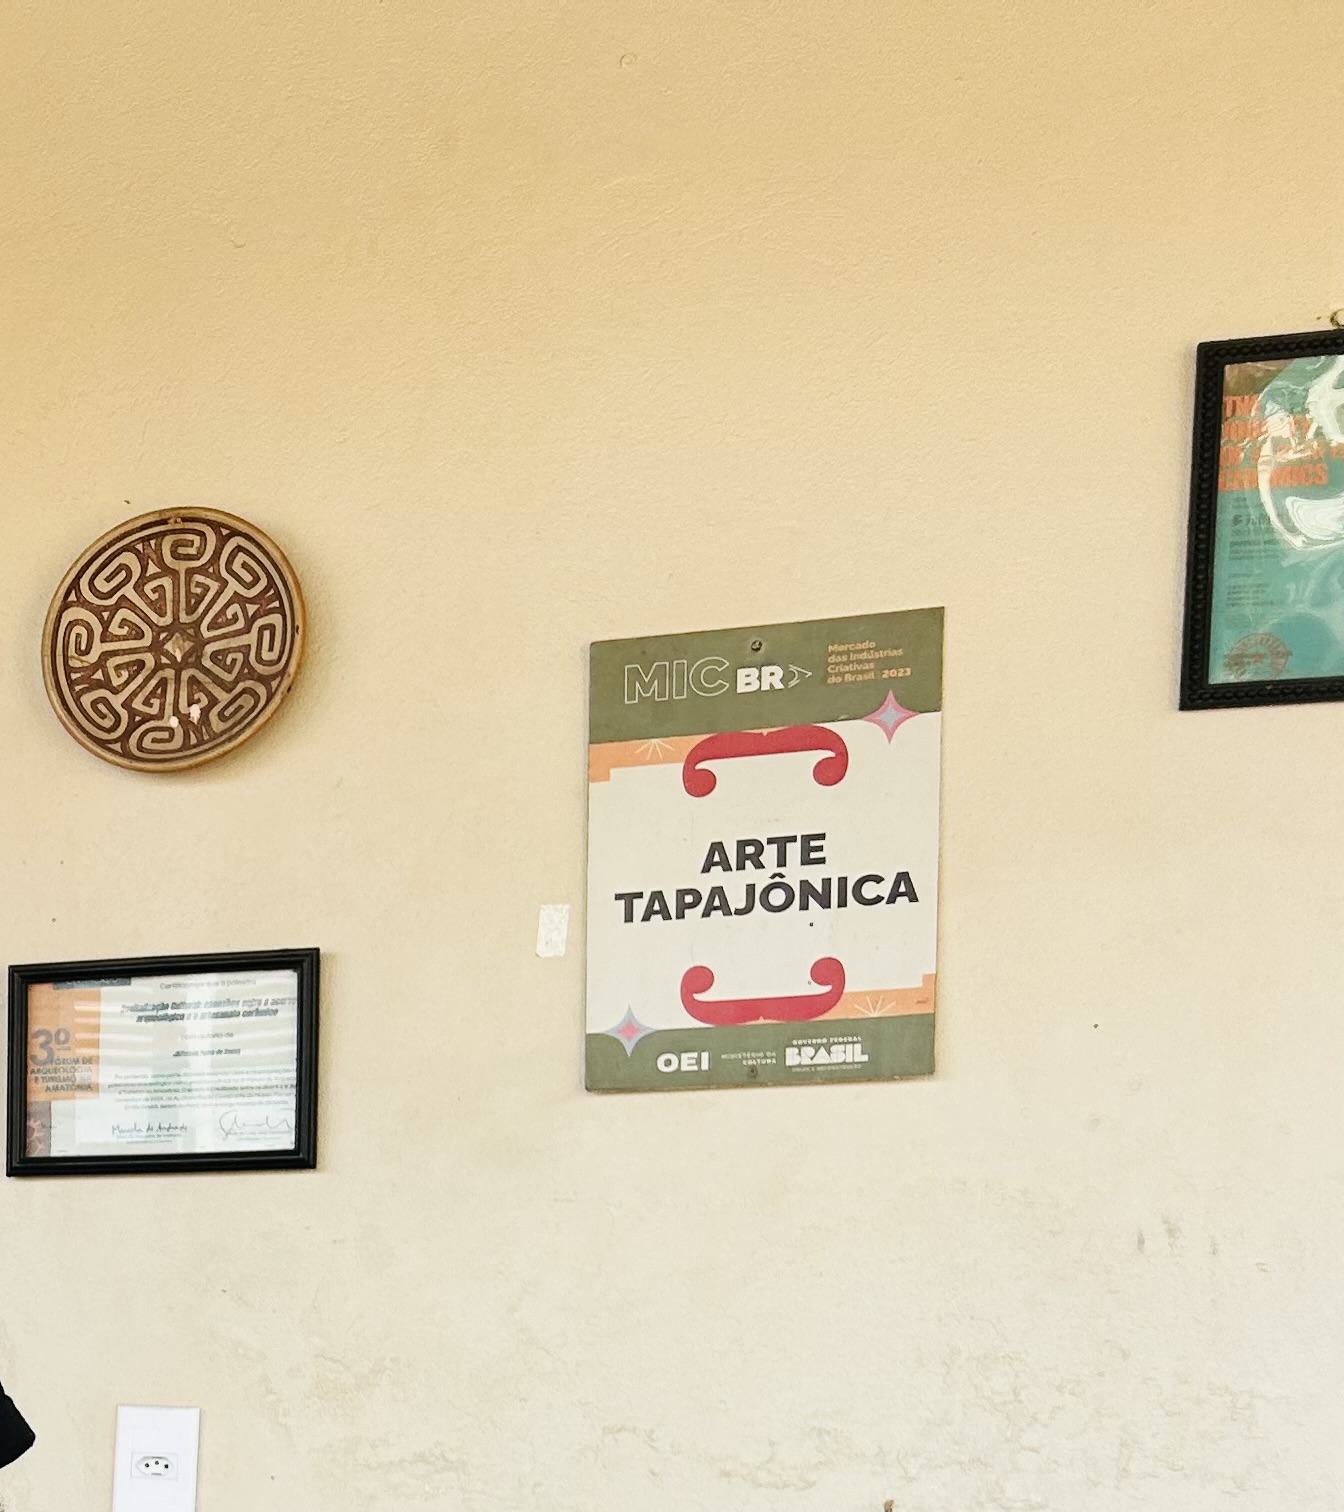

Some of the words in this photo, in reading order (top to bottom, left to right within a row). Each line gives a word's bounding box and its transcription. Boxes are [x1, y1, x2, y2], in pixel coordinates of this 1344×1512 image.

[827, 640, 876, 653] Mercado
[827, 654, 848, 664] das
[827, 662, 875, 673] Criativas
[624, 656, 730, 704] MIC
[736, 664, 784, 694] BR
[827, 674, 843, 684] do
[844, 671, 875, 682] Brasil
[881, 667, 912, 679] 2023
[700, 832, 827, 874] ARTE
[614, 870, 920, 924] TAPAJÔNICA
[656, 1051, 710, 1073] OEI
[785, 1043, 869, 1066] BRASIL
